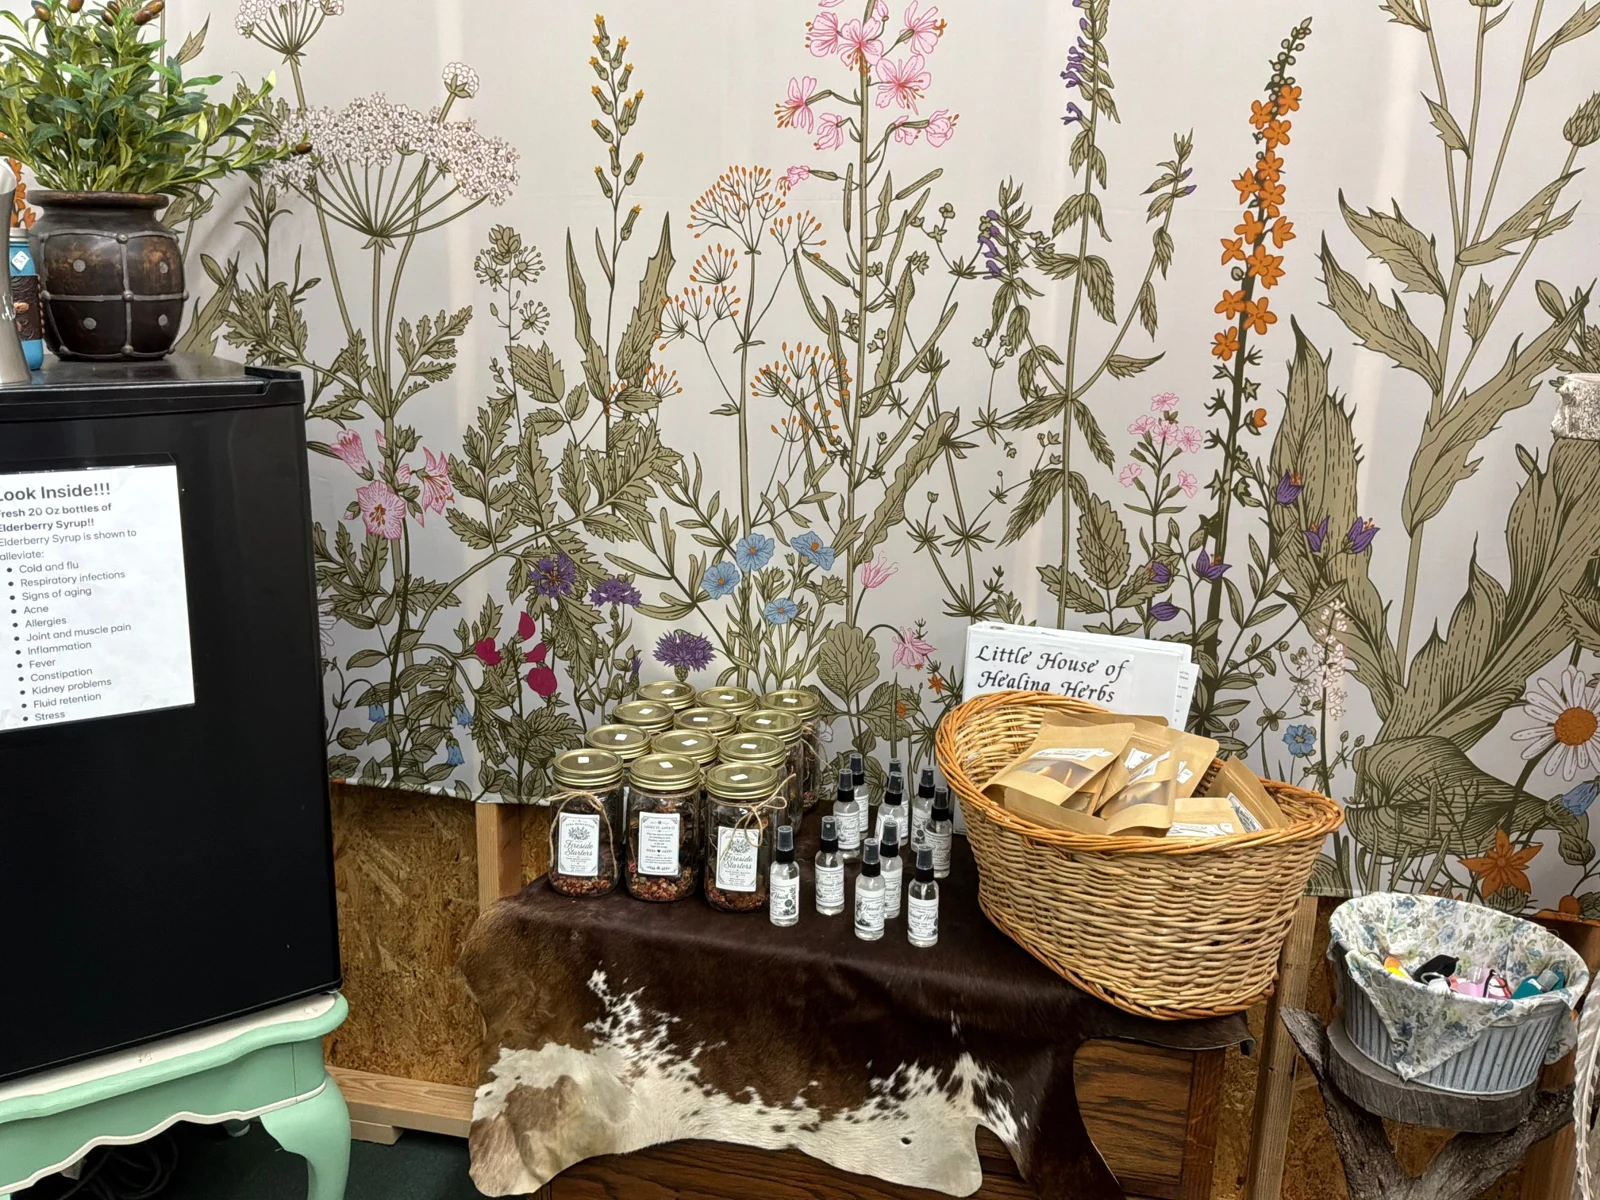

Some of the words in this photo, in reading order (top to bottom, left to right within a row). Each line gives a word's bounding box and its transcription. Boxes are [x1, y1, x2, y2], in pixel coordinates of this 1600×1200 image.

[0, 486, 37, 501] ook
[41, 482, 111, 499] Inside!!!
[0, 508, 26, 518] resh
[28, 508, 43, 516] 20
[45, 506, 60, 516] Oz
[62, 504, 100, 514] bottles
[102, 503, 112, 512] of
[56, 518, 94, 530] Syrup!!
[52, 534, 81, 544] Syrup
[83, 532, 92, 541] is
[94, 530, 125, 540] shown
[127, 529, 137, 538] to
[0, 550, 44, 561] alleviate:
[19, 564, 43, 574] Cold
[45, 562, 64, 572] and
[66, 561, 79, 570] flu
[21, 575, 77, 588] Respiratory
[79, 570, 125, 582] infections
[22, 591, 50, 601] Signs
[52, 589, 62, 598] of
[64, 586, 92, 598] aging
[24, 605, 49, 614] Acne
[25, 616, 67, 628] Allergies
[26, 632, 51, 642] Joint
[53, 629, 72, 639] and
[74, 625, 109, 637] muscle
[111, 623, 131, 634] pain
[28, 641, 92, 655] Inflammation
[30, 658, 56, 668] Fever
[975, 645, 1032, 664] Little
[1037, 652, 1099, 674] House
[1105, 660, 1129, 684] of
[31, 668, 93, 682] Constipation
[32, 684, 65, 696] Kidney
[68, 678, 112, 692] problems
[977, 670, 1050, 692] Healing
[1058, 681, 1114, 702] Herbs
[34, 698, 57, 708] Fluid
[59, 692, 102, 706] retention
[35, 710, 65, 721] Stress
